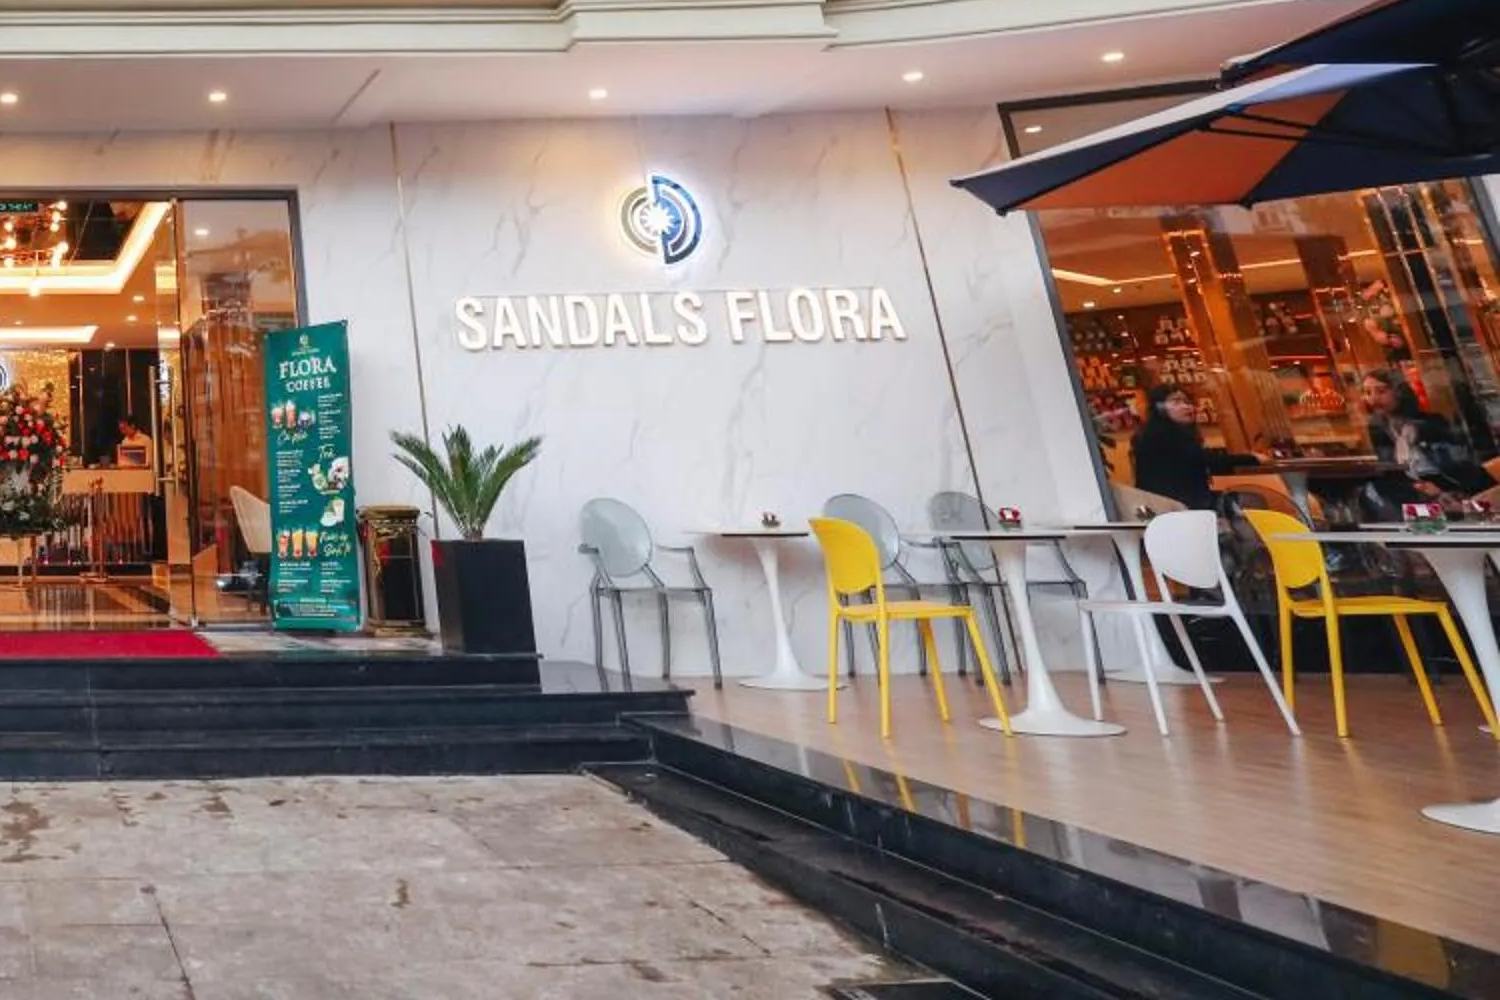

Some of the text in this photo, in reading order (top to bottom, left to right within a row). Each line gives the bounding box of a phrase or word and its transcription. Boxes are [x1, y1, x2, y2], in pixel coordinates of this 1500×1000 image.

[454, 286, 908, 352] SANDALS FLORA
[279, 355, 337, 379] FLORA
[285, 376, 331, 393] COFFEE
